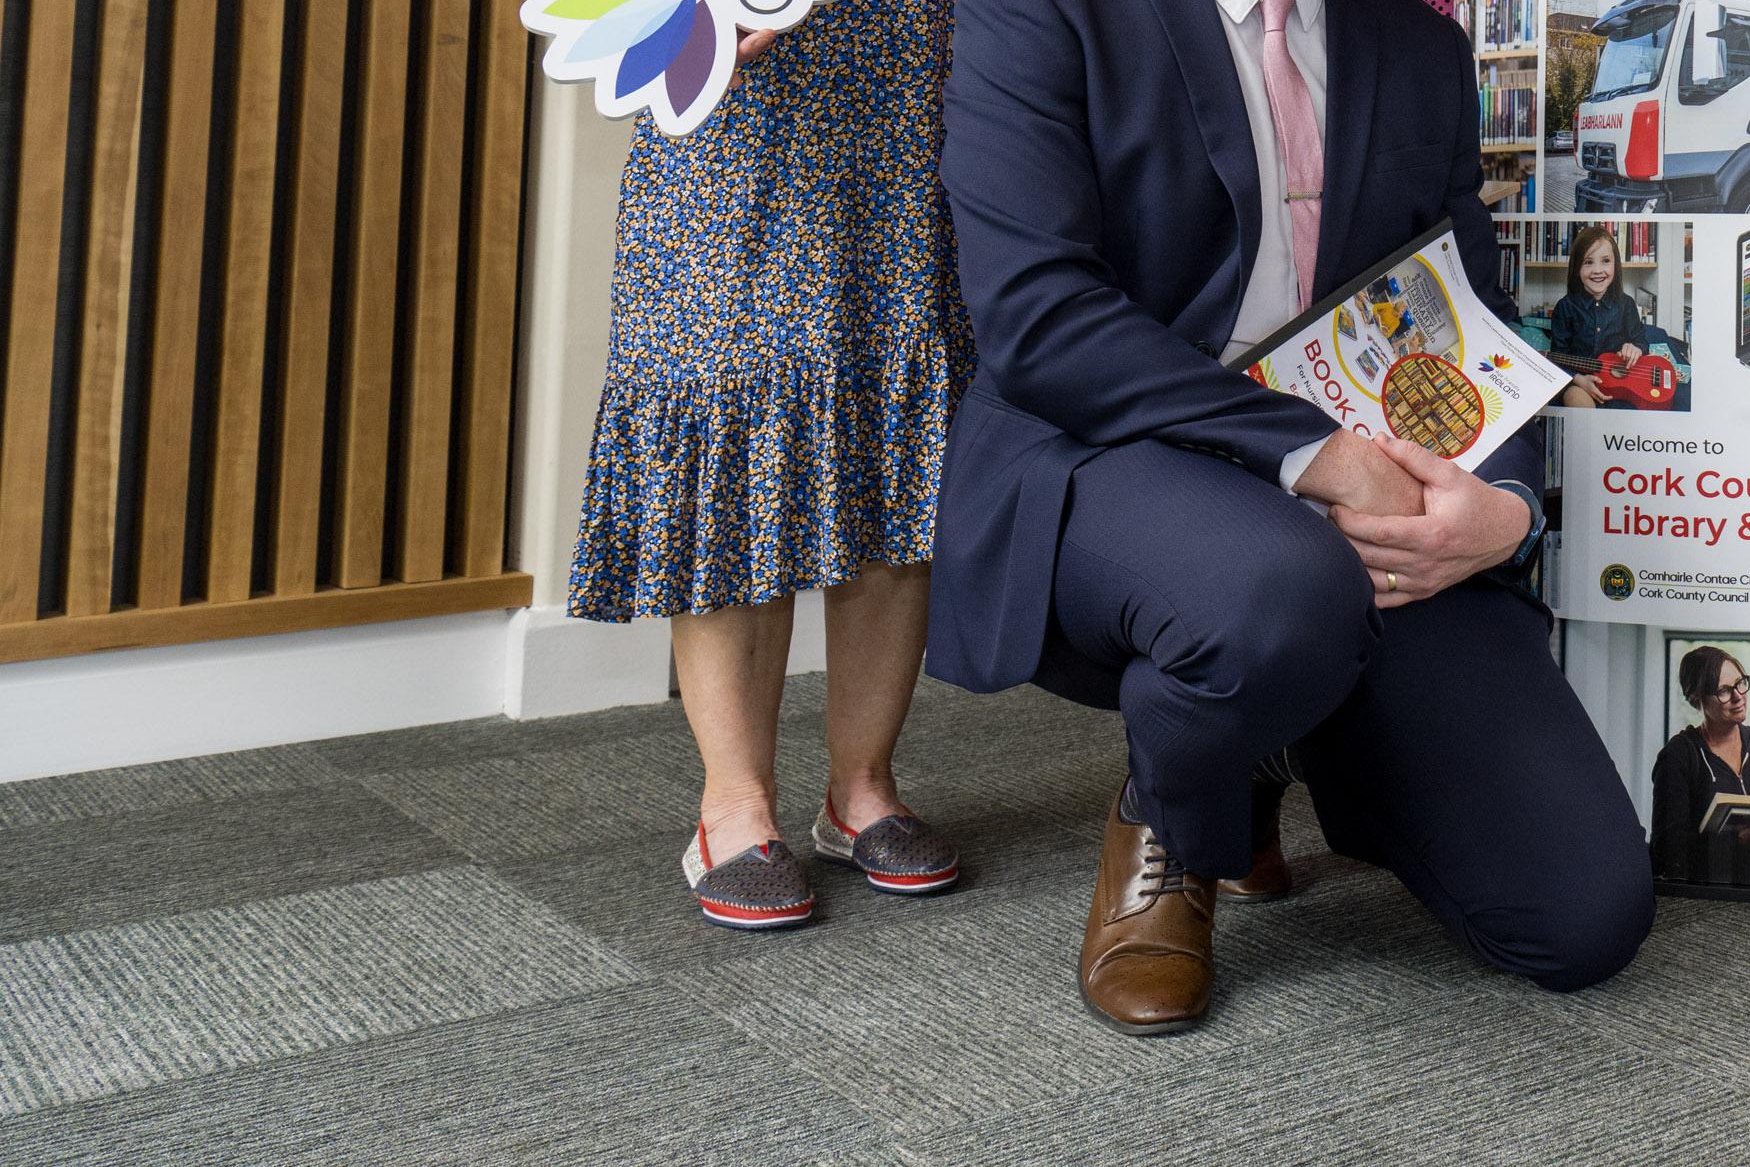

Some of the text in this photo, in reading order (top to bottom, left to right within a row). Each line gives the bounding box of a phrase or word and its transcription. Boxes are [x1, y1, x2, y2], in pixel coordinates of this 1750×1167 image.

[1580, 113, 1623, 130] LEABHARLANN
[1411, 288, 1434, 329] LIBRARY
[1413, 307, 1436, 344] question
[1296, 363, 1306, 379] For
[1304, 339, 1356, 422] BOOK
[1603, 434, 1724, 455] Welcome to
[1602, 466, 1685, 498] Cork
[1603, 506, 1728, 547] Library
[1638, 569, 1693, 583] Comhairle
[1695, 572, 1737, 585] Contae
[1638, 587, 1749, 603] Cork County Council
